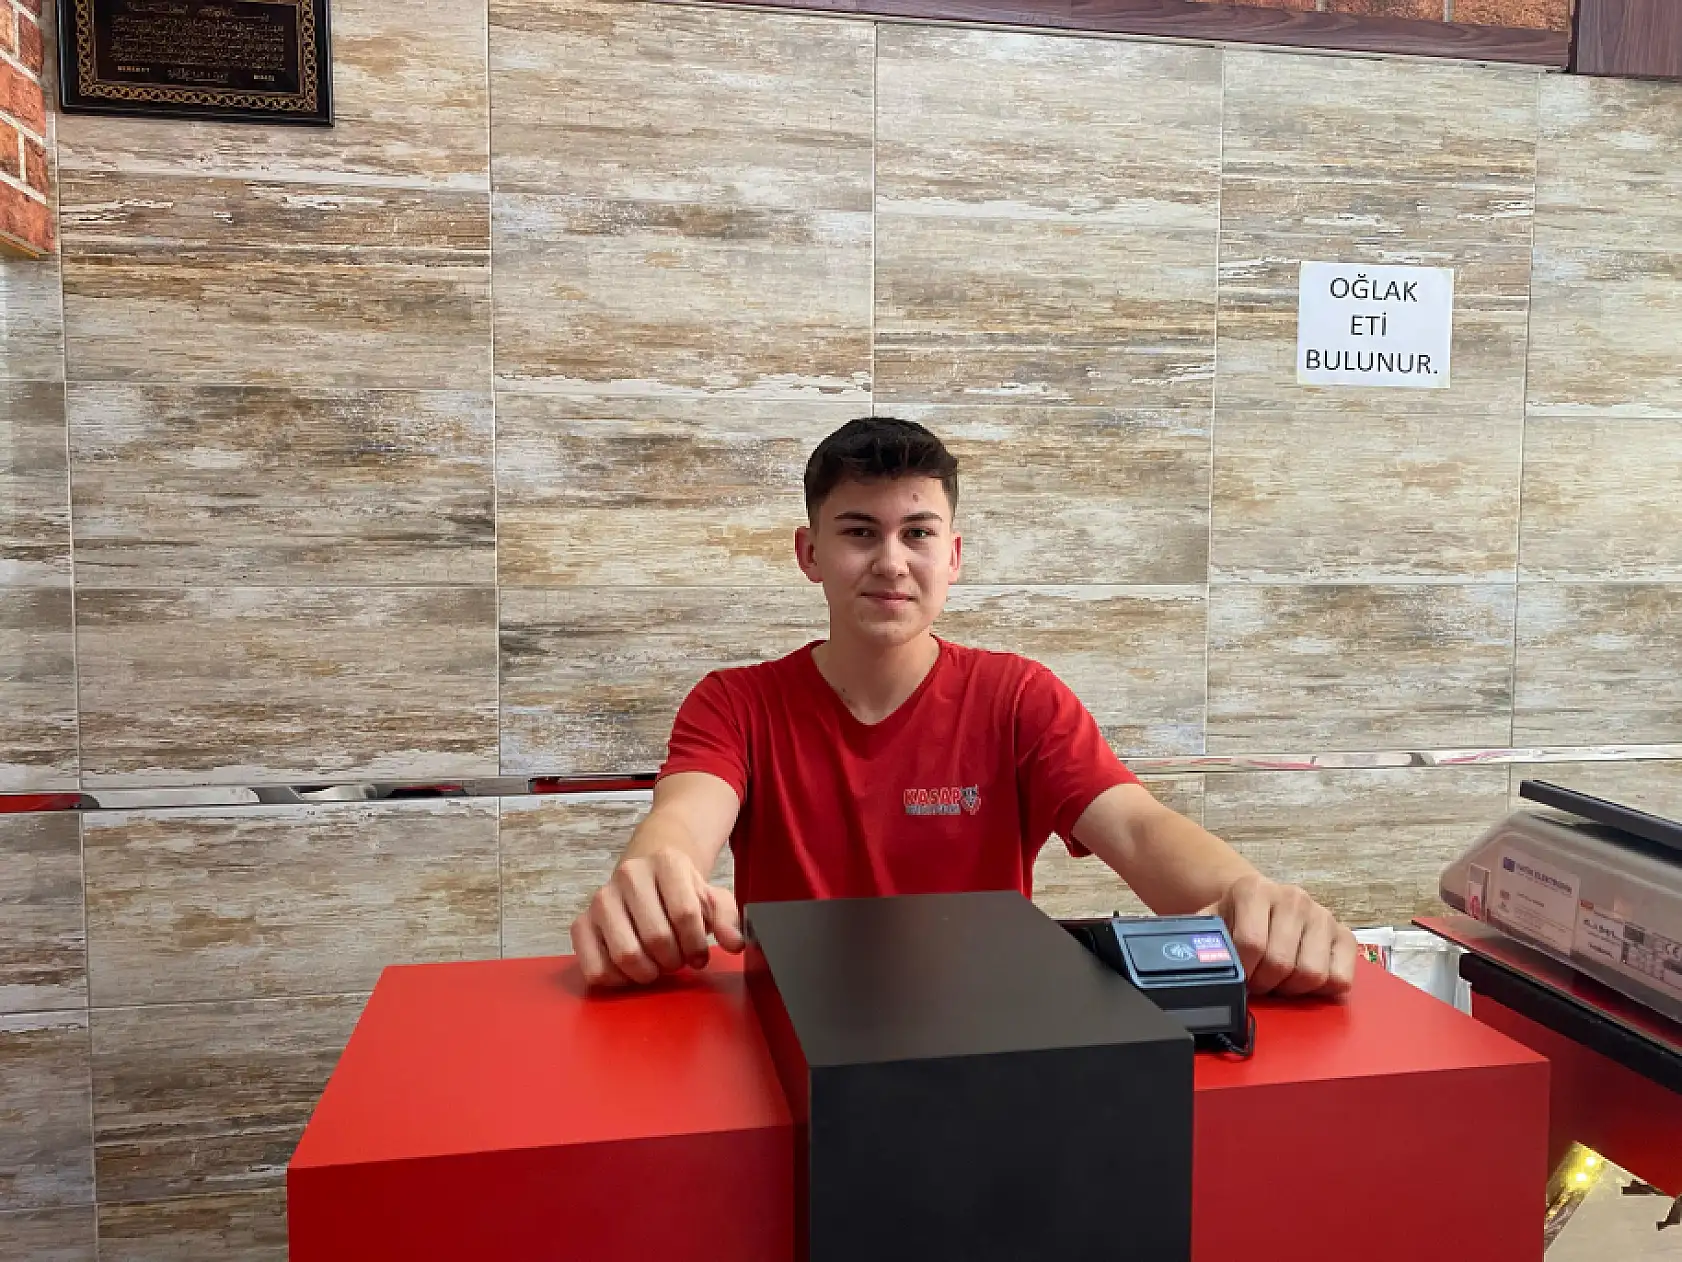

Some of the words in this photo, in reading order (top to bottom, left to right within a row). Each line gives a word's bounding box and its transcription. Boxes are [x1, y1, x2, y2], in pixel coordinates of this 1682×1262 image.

[1330, 273, 1418, 302] OĞLAK
[1350, 311, 1387, 337] ETİ
[1306, 349, 1438, 374] BULUNUR.
